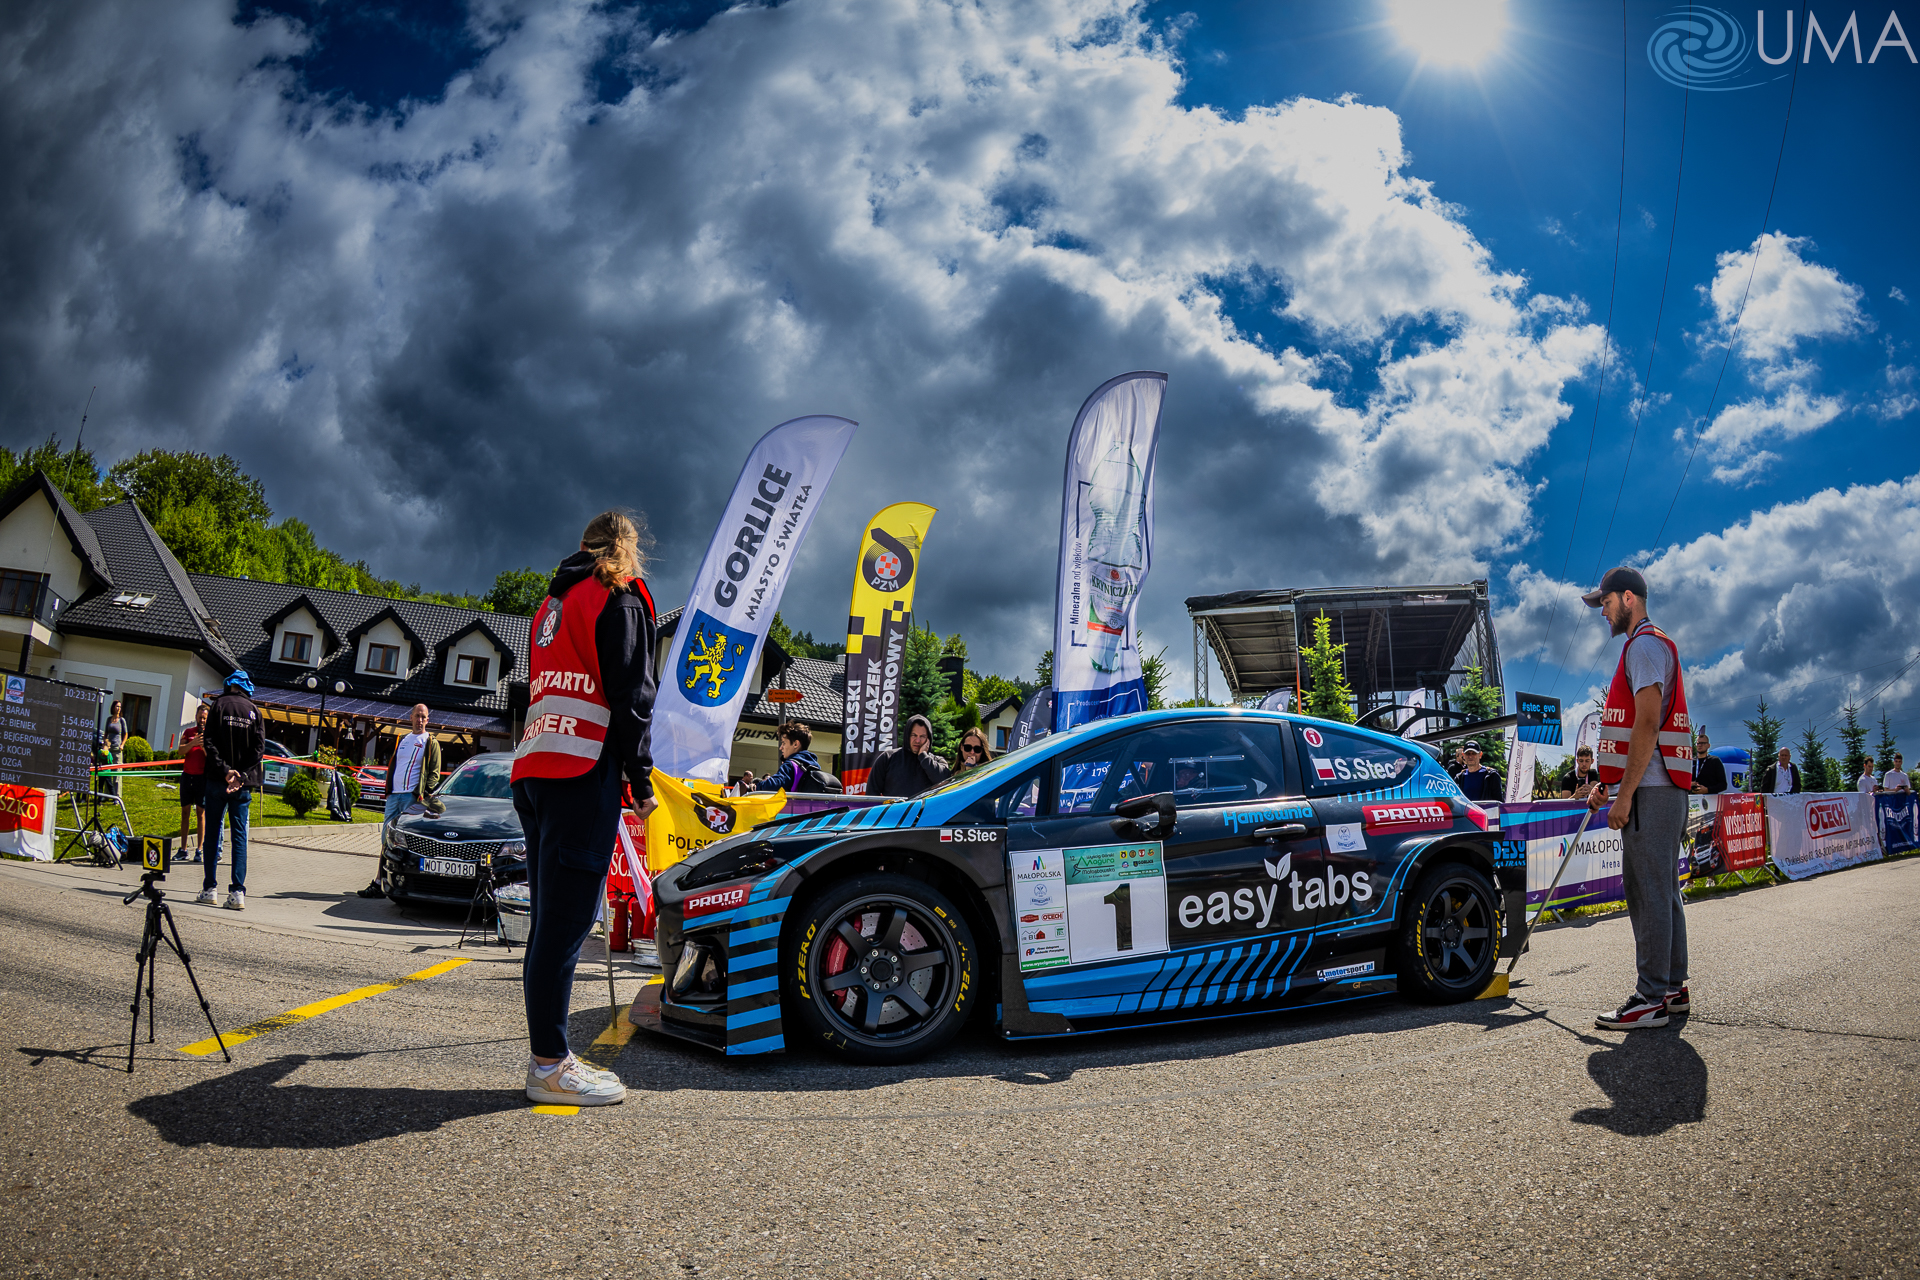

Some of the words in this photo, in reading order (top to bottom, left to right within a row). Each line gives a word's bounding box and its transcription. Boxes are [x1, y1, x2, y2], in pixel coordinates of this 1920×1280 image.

[714, 463, 792, 608] GORLICE
[745, 553, 780, 621] MIASTO
[773, 484, 812, 551] ŚWIATŁA
[1072, 541, 1082, 569] wieków
[870, 576, 900, 592] PZM
[1071, 570, 1081, 579] od
[1069, 581, 1081, 625] Mineralna
[64, 687, 97, 702] 10:23:12
[878, 628, 904, 752] MOTOROWY
[861, 657, 882, 754] ZWIĄZEK
[1522, 701, 1556, 714] #stec_evo
[5, 705, 31, 717] BARAN
[62, 715, 95, 729] 1:54.699
[521, 712, 578, 742] TARTER
[845, 679, 862, 755] POLSKI
[9, 718, 37, 731] BIENIEK
[60, 727, 94, 741] 2:00.796
[3, 730, 52, 747] BEJGEROWSKI
[59, 740, 92, 753] 2:01.205
[1600, 739, 1617, 754] ER
[7, 745, 32, 757] KOCUR
[58, 753, 92, 766] 2:01.620
[1, 757, 23, 768] OZGA
[57, 765, 91, 778] 2:02.326
[1333, 757, 1398, 781] S.Stec
[1, 772, 22, 783] BIAŁY
[57, 780, 90, 792] 2:08.125
[1425, 779, 1457, 793] MOTO
[1370, 805, 1445, 822] PROTO
[1418, 816, 1445, 824] SLEEVE
[953, 828, 998, 843] S.Stec
[1575, 838, 1624, 856] MAŁOPOL
[424, 859, 443, 872] WOT
[444, 861, 475, 877] 90180
[1017, 870, 1062, 880] MAŁOPOLSKA
[1601, 859, 1621, 870] Arena
[688, 889, 744, 910] PROTO
[1178, 882, 1279, 930] easy
[1288, 864, 1374, 912] tabs
[1103, 882, 1134, 952] 1
[797, 922, 818, 984] ZERO
[1318, 962, 1375, 979] 4motorsport.pl
[799, 984, 811, 1000] P
